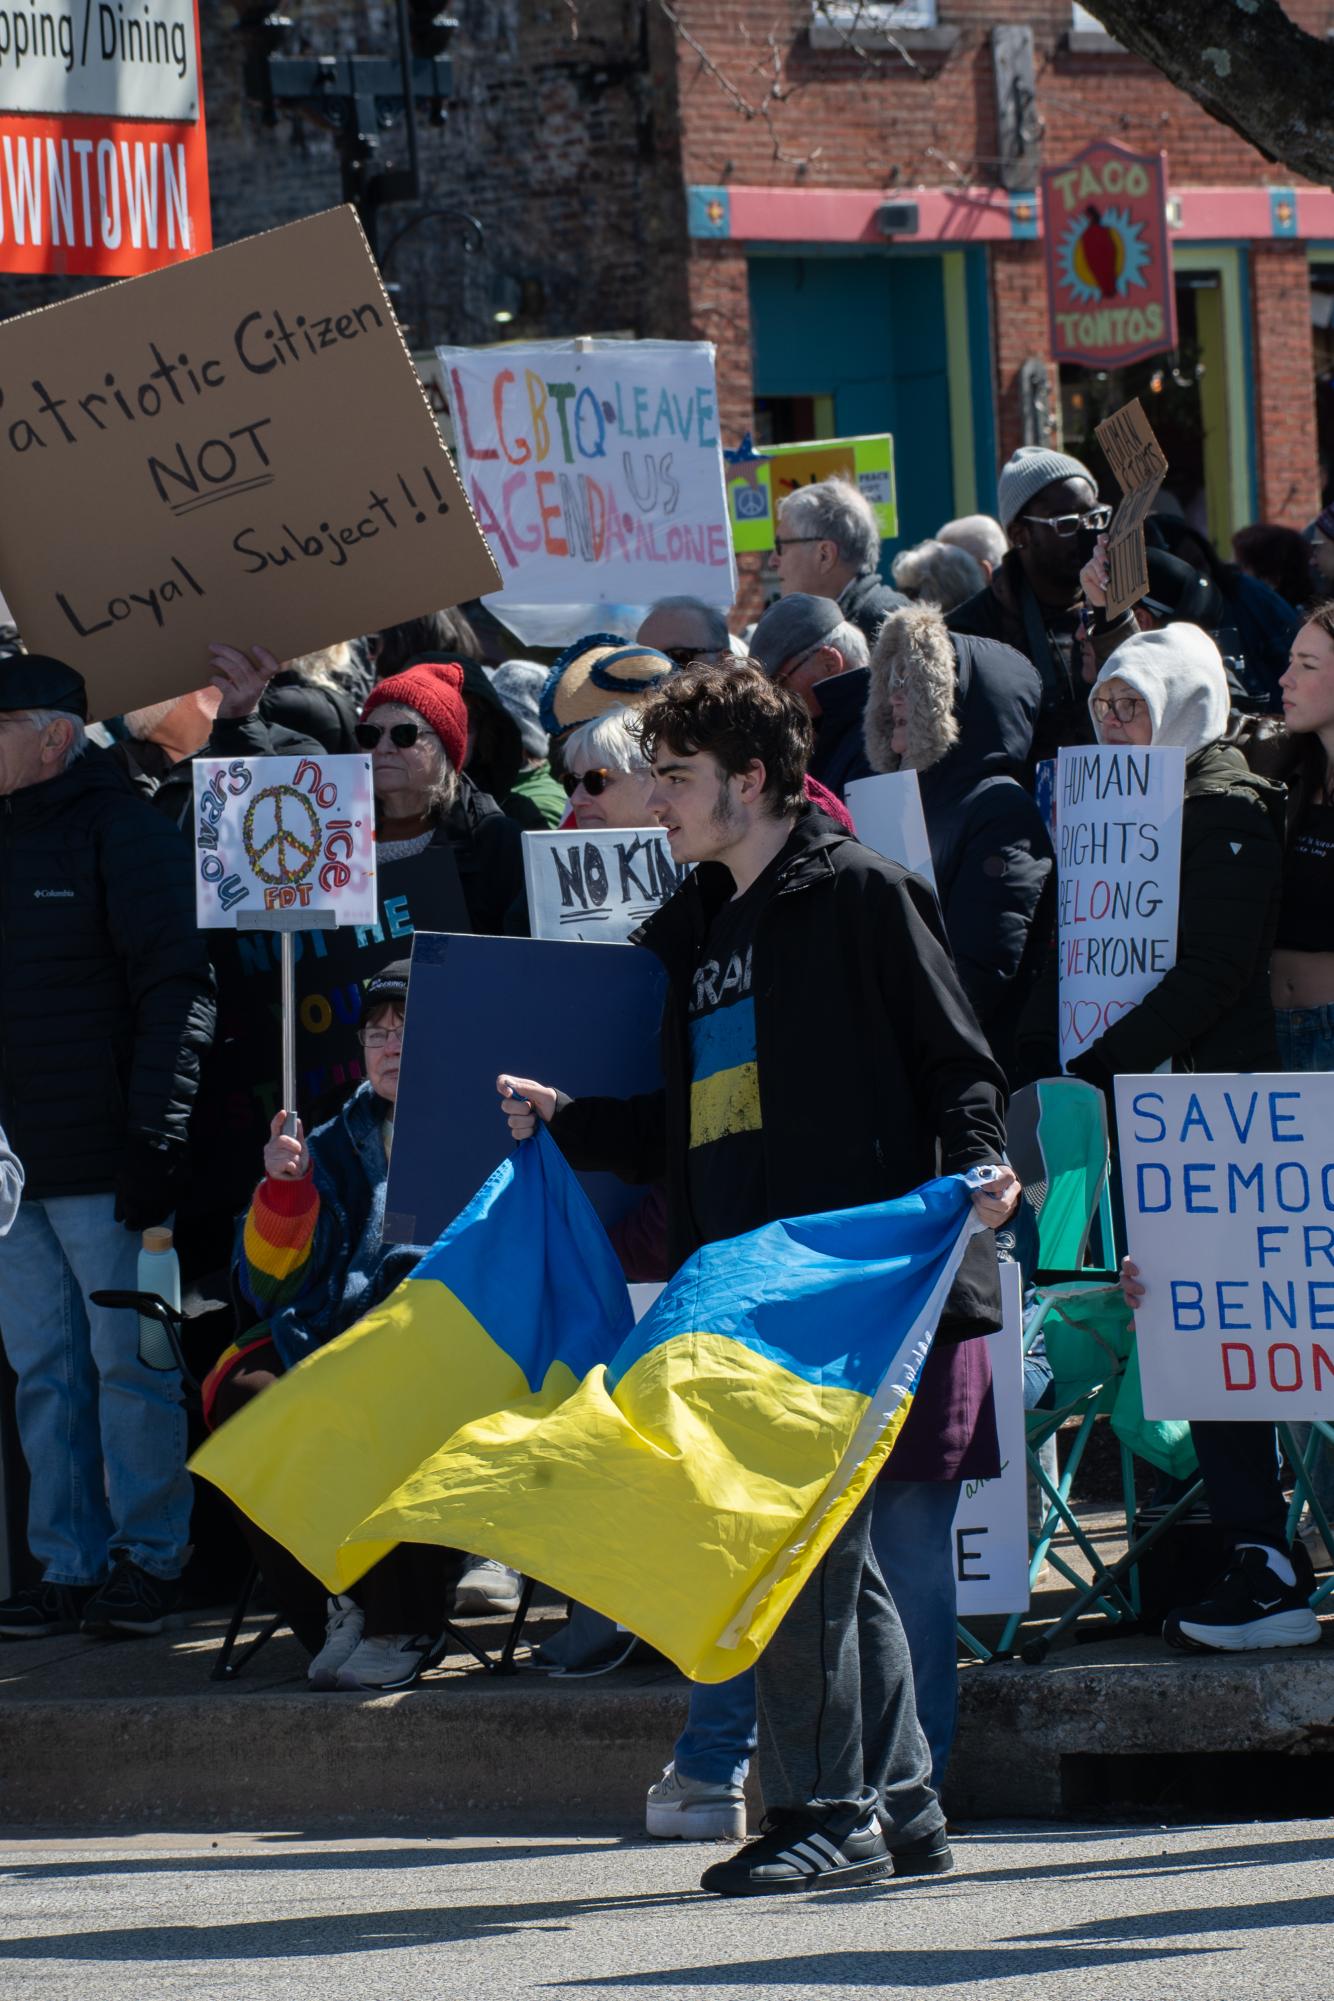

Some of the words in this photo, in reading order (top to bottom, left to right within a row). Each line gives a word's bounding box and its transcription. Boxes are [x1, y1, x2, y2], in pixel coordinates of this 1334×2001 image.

[0, 135, 190, 250] WNTOWN
[1053, 161, 1150, 212] TACO
[1056, 303, 1164, 347] TONTOS
[0, 342, 226, 452] atriotic
[235, 303, 384, 375] Citizen
[451, 367, 606, 466] LGBTQ
[614, 381, 718, 449] LEAVE
[147, 417, 272, 504] NOT
[622, 451, 680, 515] US
[55, 555, 206, 637] Loyal
[233, 466, 450, 573] Subject!!
[470, 470, 629, 569] AGENDA
[634, 522, 729, 567] ALONE
[1063, 753, 1150, 808] HUMAN
[293, 758, 337, 809] no
[319, 820, 363, 892] ice
[1061, 822, 1160, 869] RIGHTS
[263, 882, 314, 911] FDT
[551, 842, 609, 909] NO
[613, 832, 691, 906] KIN
[688, 943, 753, 1014] RAI
[1132, 1091, 1305, 1144] SAVE
